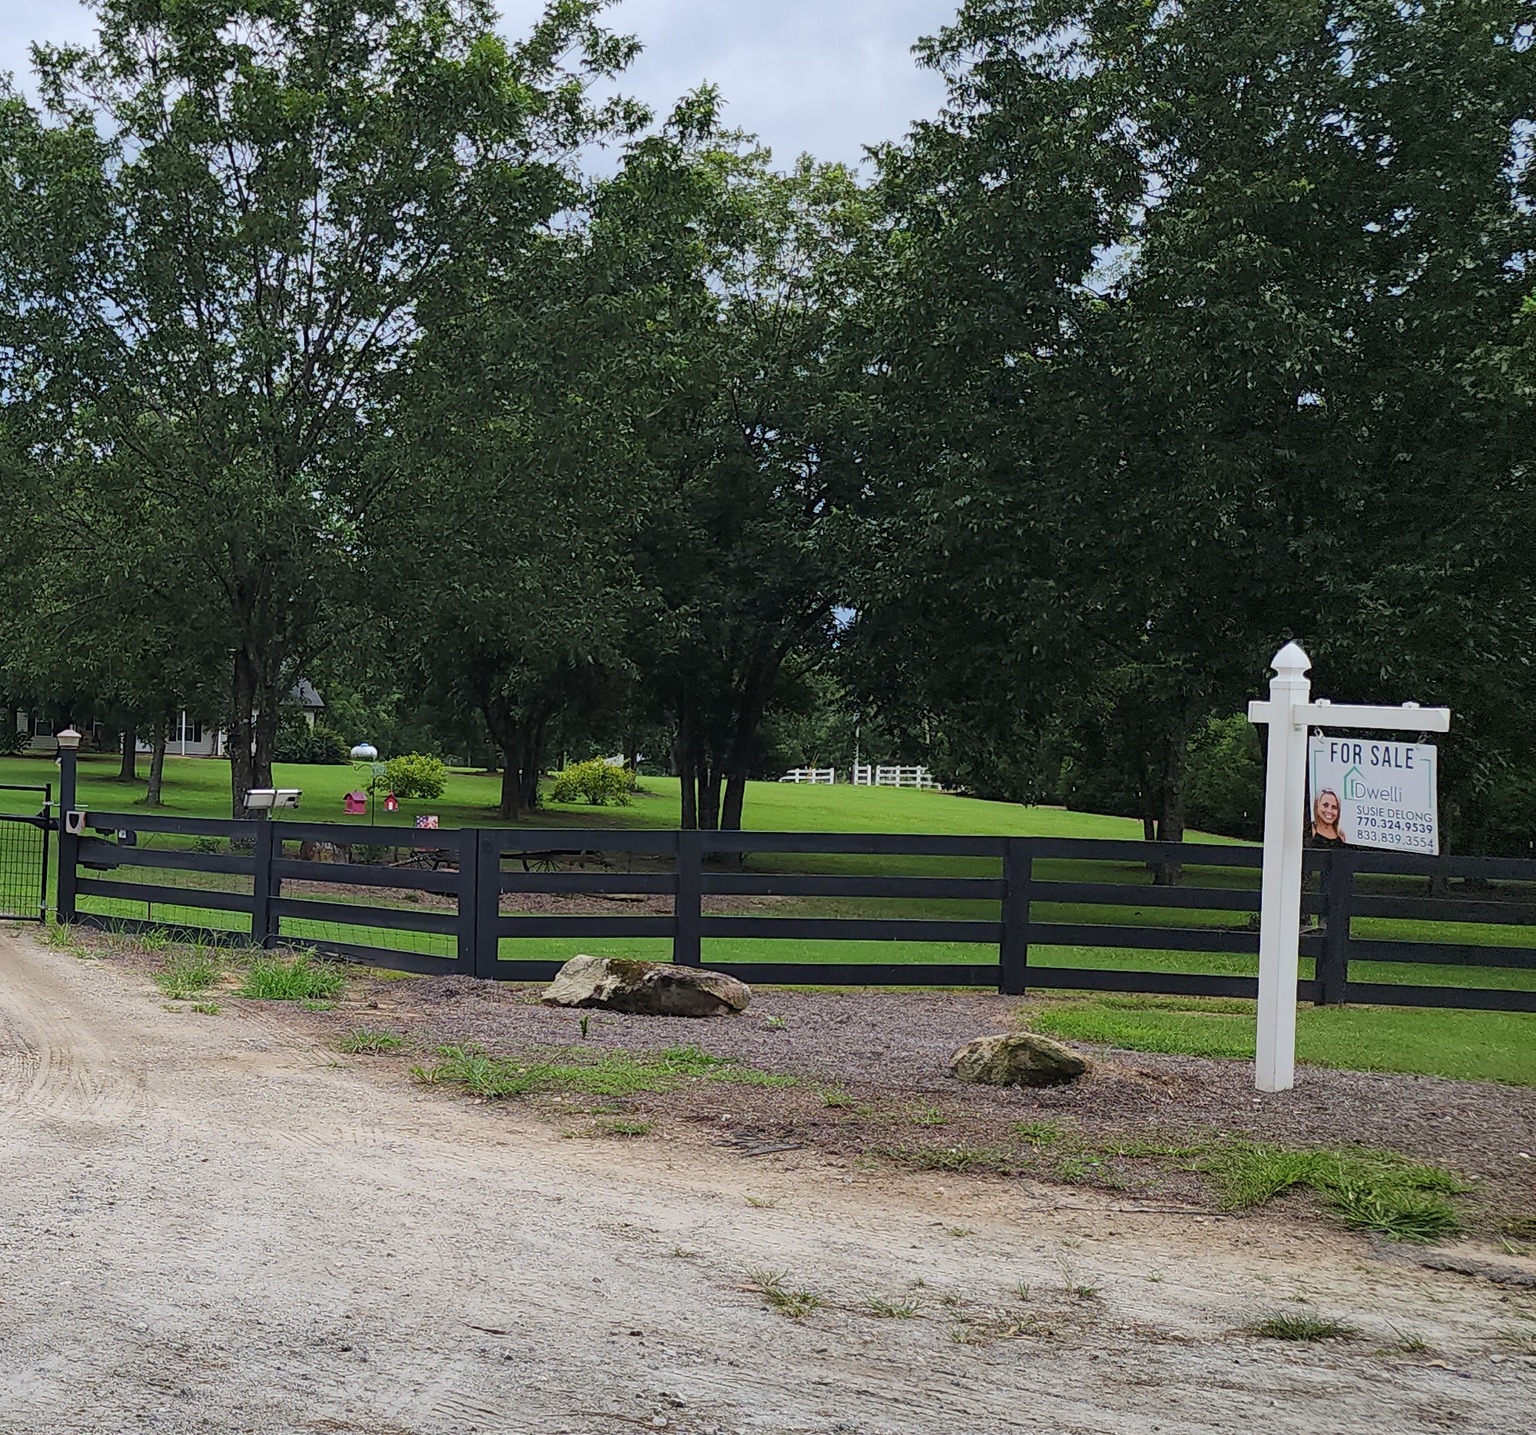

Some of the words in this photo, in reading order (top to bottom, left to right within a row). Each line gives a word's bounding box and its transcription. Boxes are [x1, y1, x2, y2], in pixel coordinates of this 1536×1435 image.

[1331, 742, 1362, 765] FOR
[1371, 745, 1414, 769] SALE
[1355, 782, 1402, 803] Dwelli
[1356, 805, 1384, 817] SUSIE
[1387, 809, 1433, 822] DELONG
[1357, 816, 1433, 834] 770.324.9539
[1357, 829, 1433, 848] 833.839.3554
